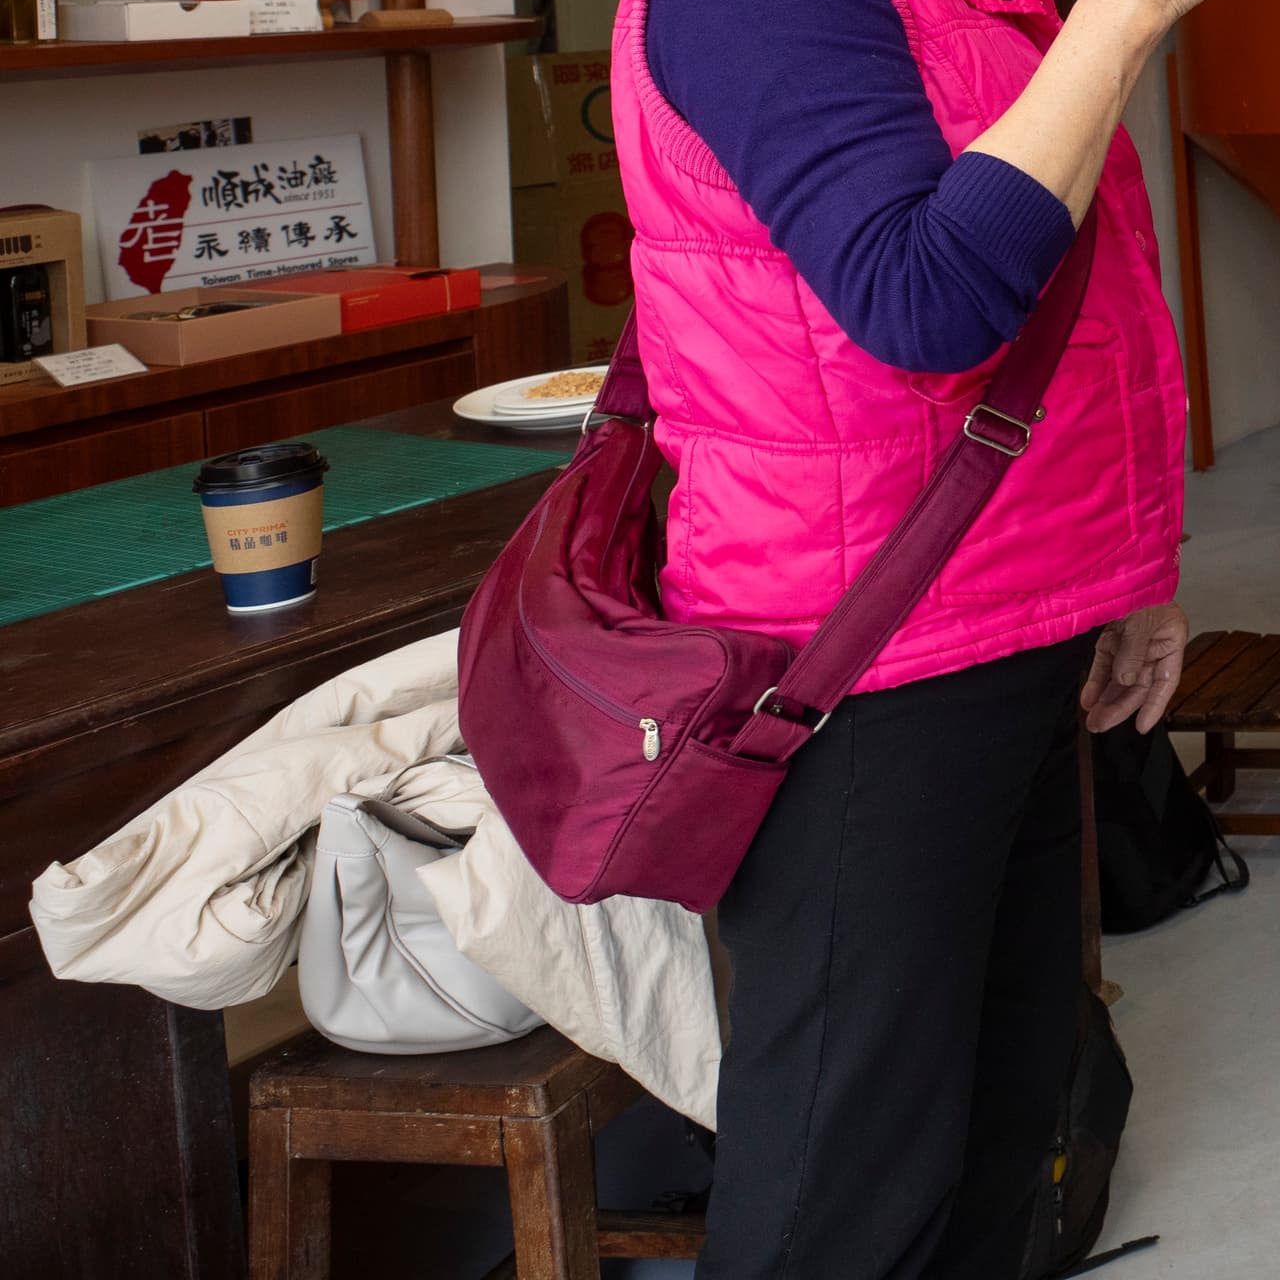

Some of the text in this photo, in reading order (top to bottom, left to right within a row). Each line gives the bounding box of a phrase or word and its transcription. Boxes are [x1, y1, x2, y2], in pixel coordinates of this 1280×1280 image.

[200, 154, 338, 211] 順成油廠
[284, 189, 335, 204] since 1951
[194, 215, 358, 260] 永續傳承
[201, 255, 359, 286] Taiwan Time-Honored Stores
[227, 522, 287, 537] CITY PRIMA
[230, 531, 288, 551] 精品咖啡
